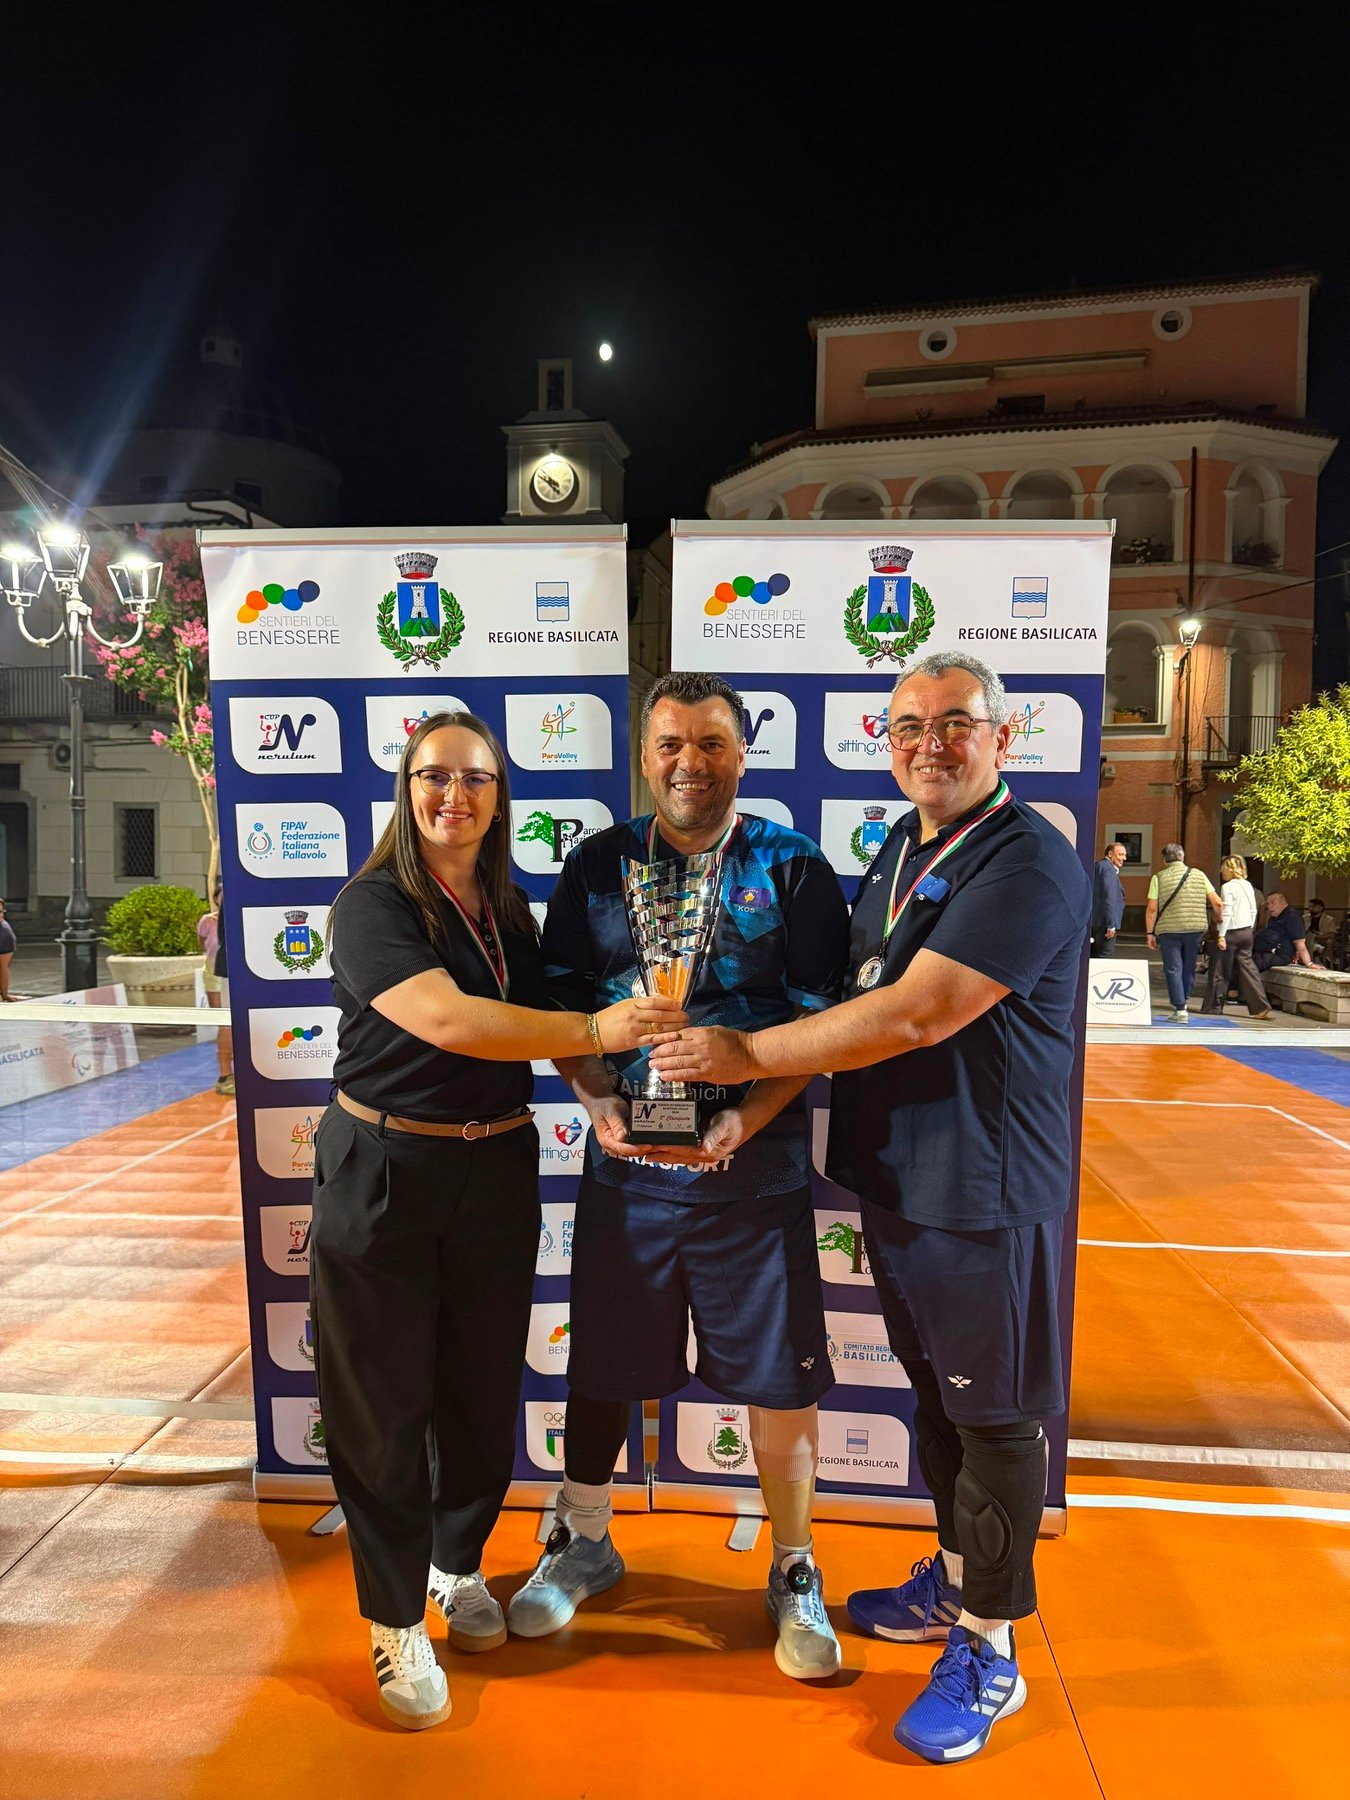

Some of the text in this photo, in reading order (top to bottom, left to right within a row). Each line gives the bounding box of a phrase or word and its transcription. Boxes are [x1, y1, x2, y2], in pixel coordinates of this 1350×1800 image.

[727, 609, 806, 620] SENTIERI DEL
[259, 615, 339, 628] SENTIERI DEL
[488, 630, 619, 643] REGIONE BASILICATA
[703, 623, 806, 639] BENESSERE
[958, 627, 1098, 640] REGIONE BASILICATA
[237, 630, 341, 646] BENESSERE
[838, 739, 893, 756] sittingvo
[257, 752, 317, 760] nerulum
[541, 752, 578, 760] ParaVolley
[1004, 753, 1044, 761] ParaVolley
[280, 821, 308, 831] FIPAV
[281, 831, 340, 840] Federazione
[282, 841, 320, 850] Italiana
[282, 850, 327, 860] Pallavolo
[737, 905, 756, 914] KOS
[277, 1049, 334, 1060] BENESSERE
[843, 1343, 875, 1351] COMITATO
[843, 1350, 899, 1363] BASILICA
[852, 1458, 899, 1469] BASILICATA
